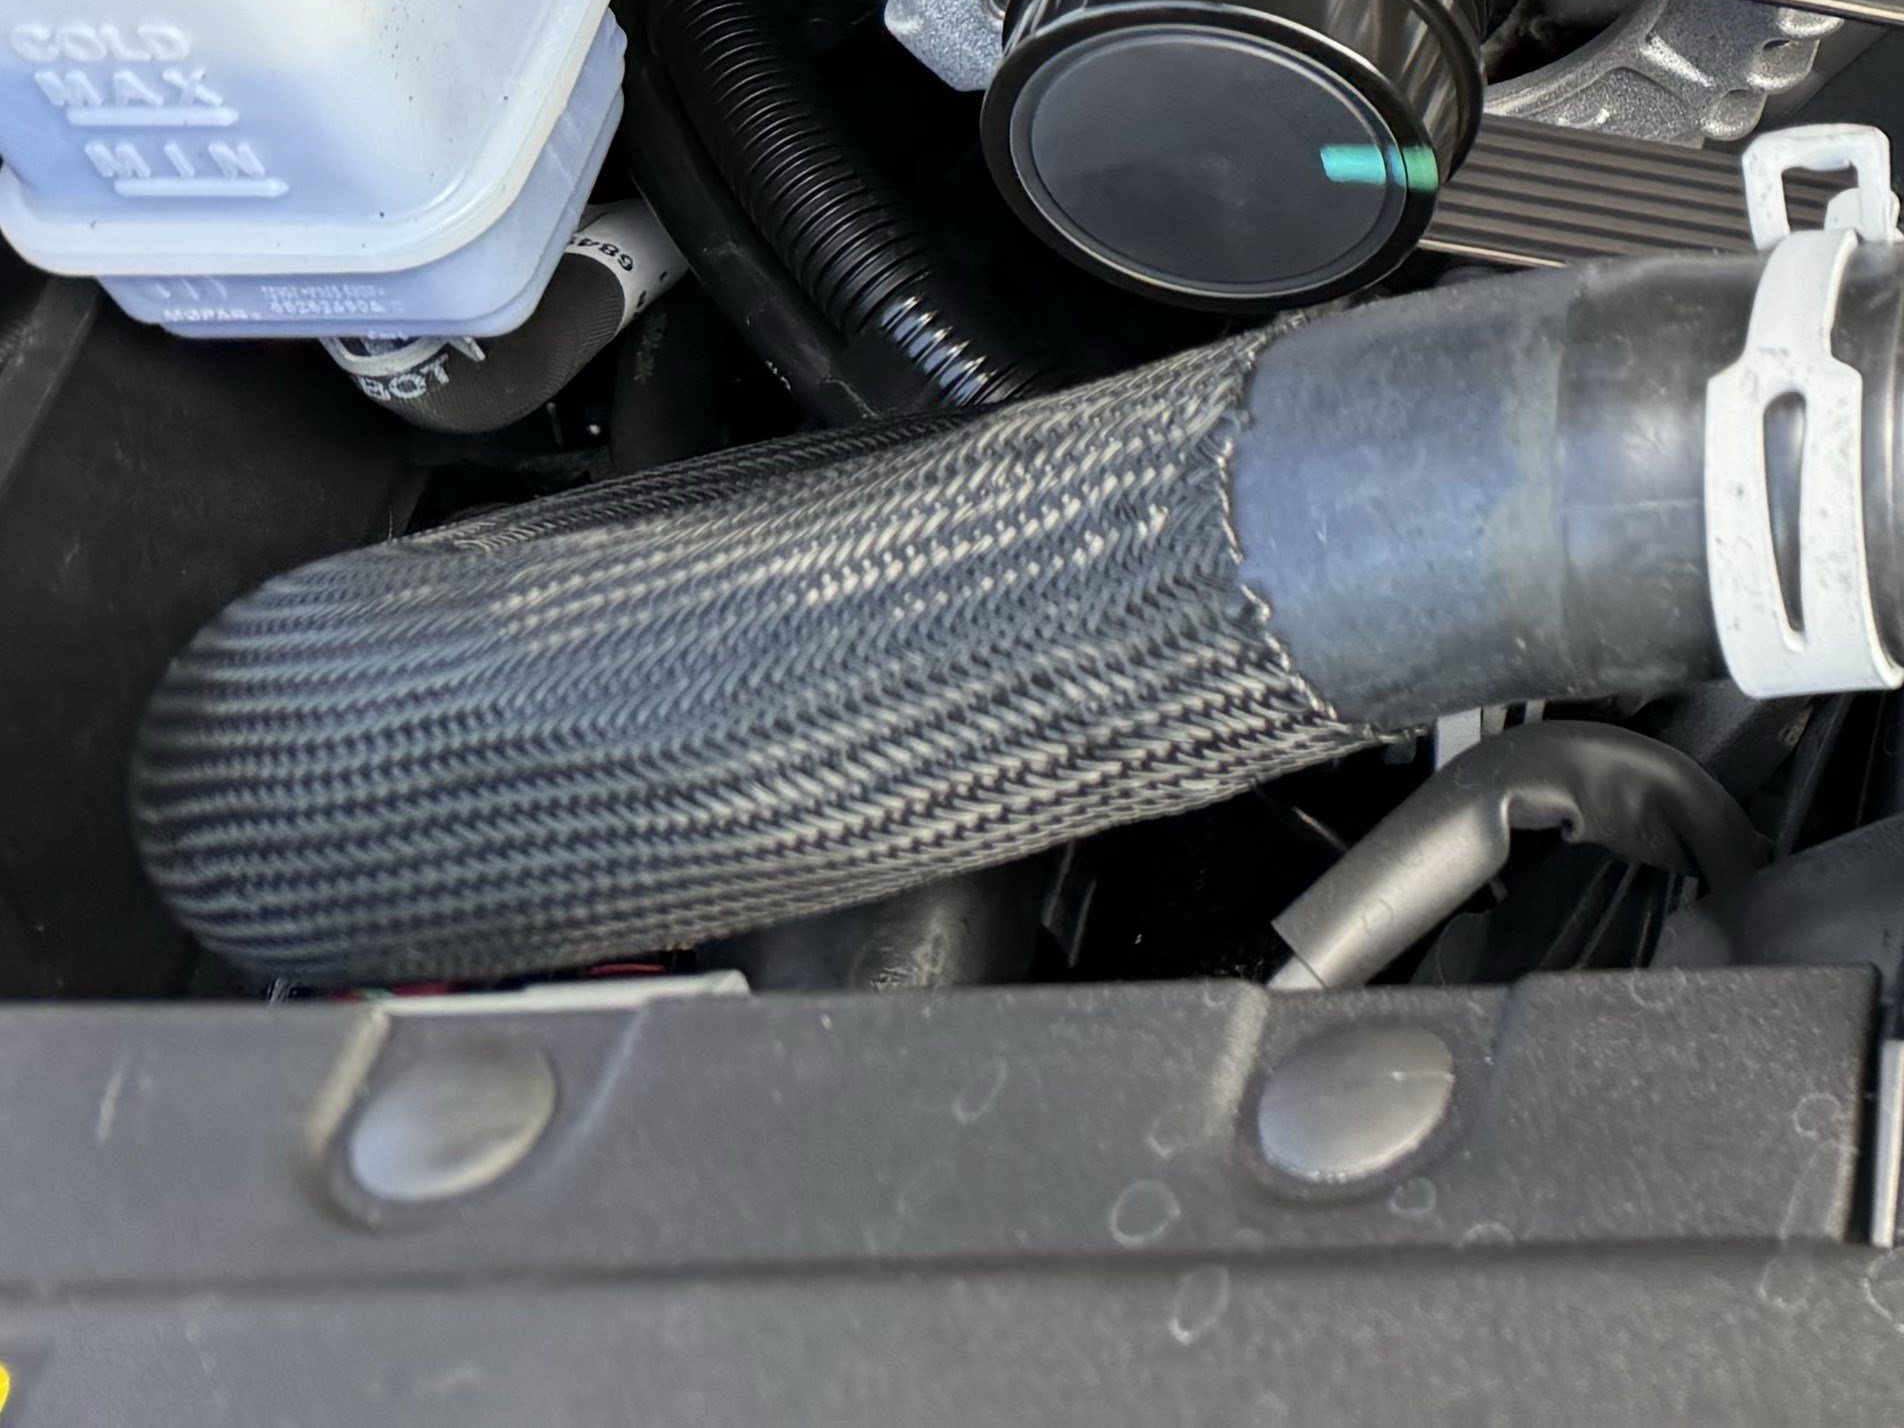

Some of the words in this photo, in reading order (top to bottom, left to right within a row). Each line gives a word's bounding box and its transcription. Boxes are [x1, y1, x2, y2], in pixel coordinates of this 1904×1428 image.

[9, 19, 193, 63] COLD
[33, 65, 225, 107] MAX
[84, 140, 267, 179] MIN
